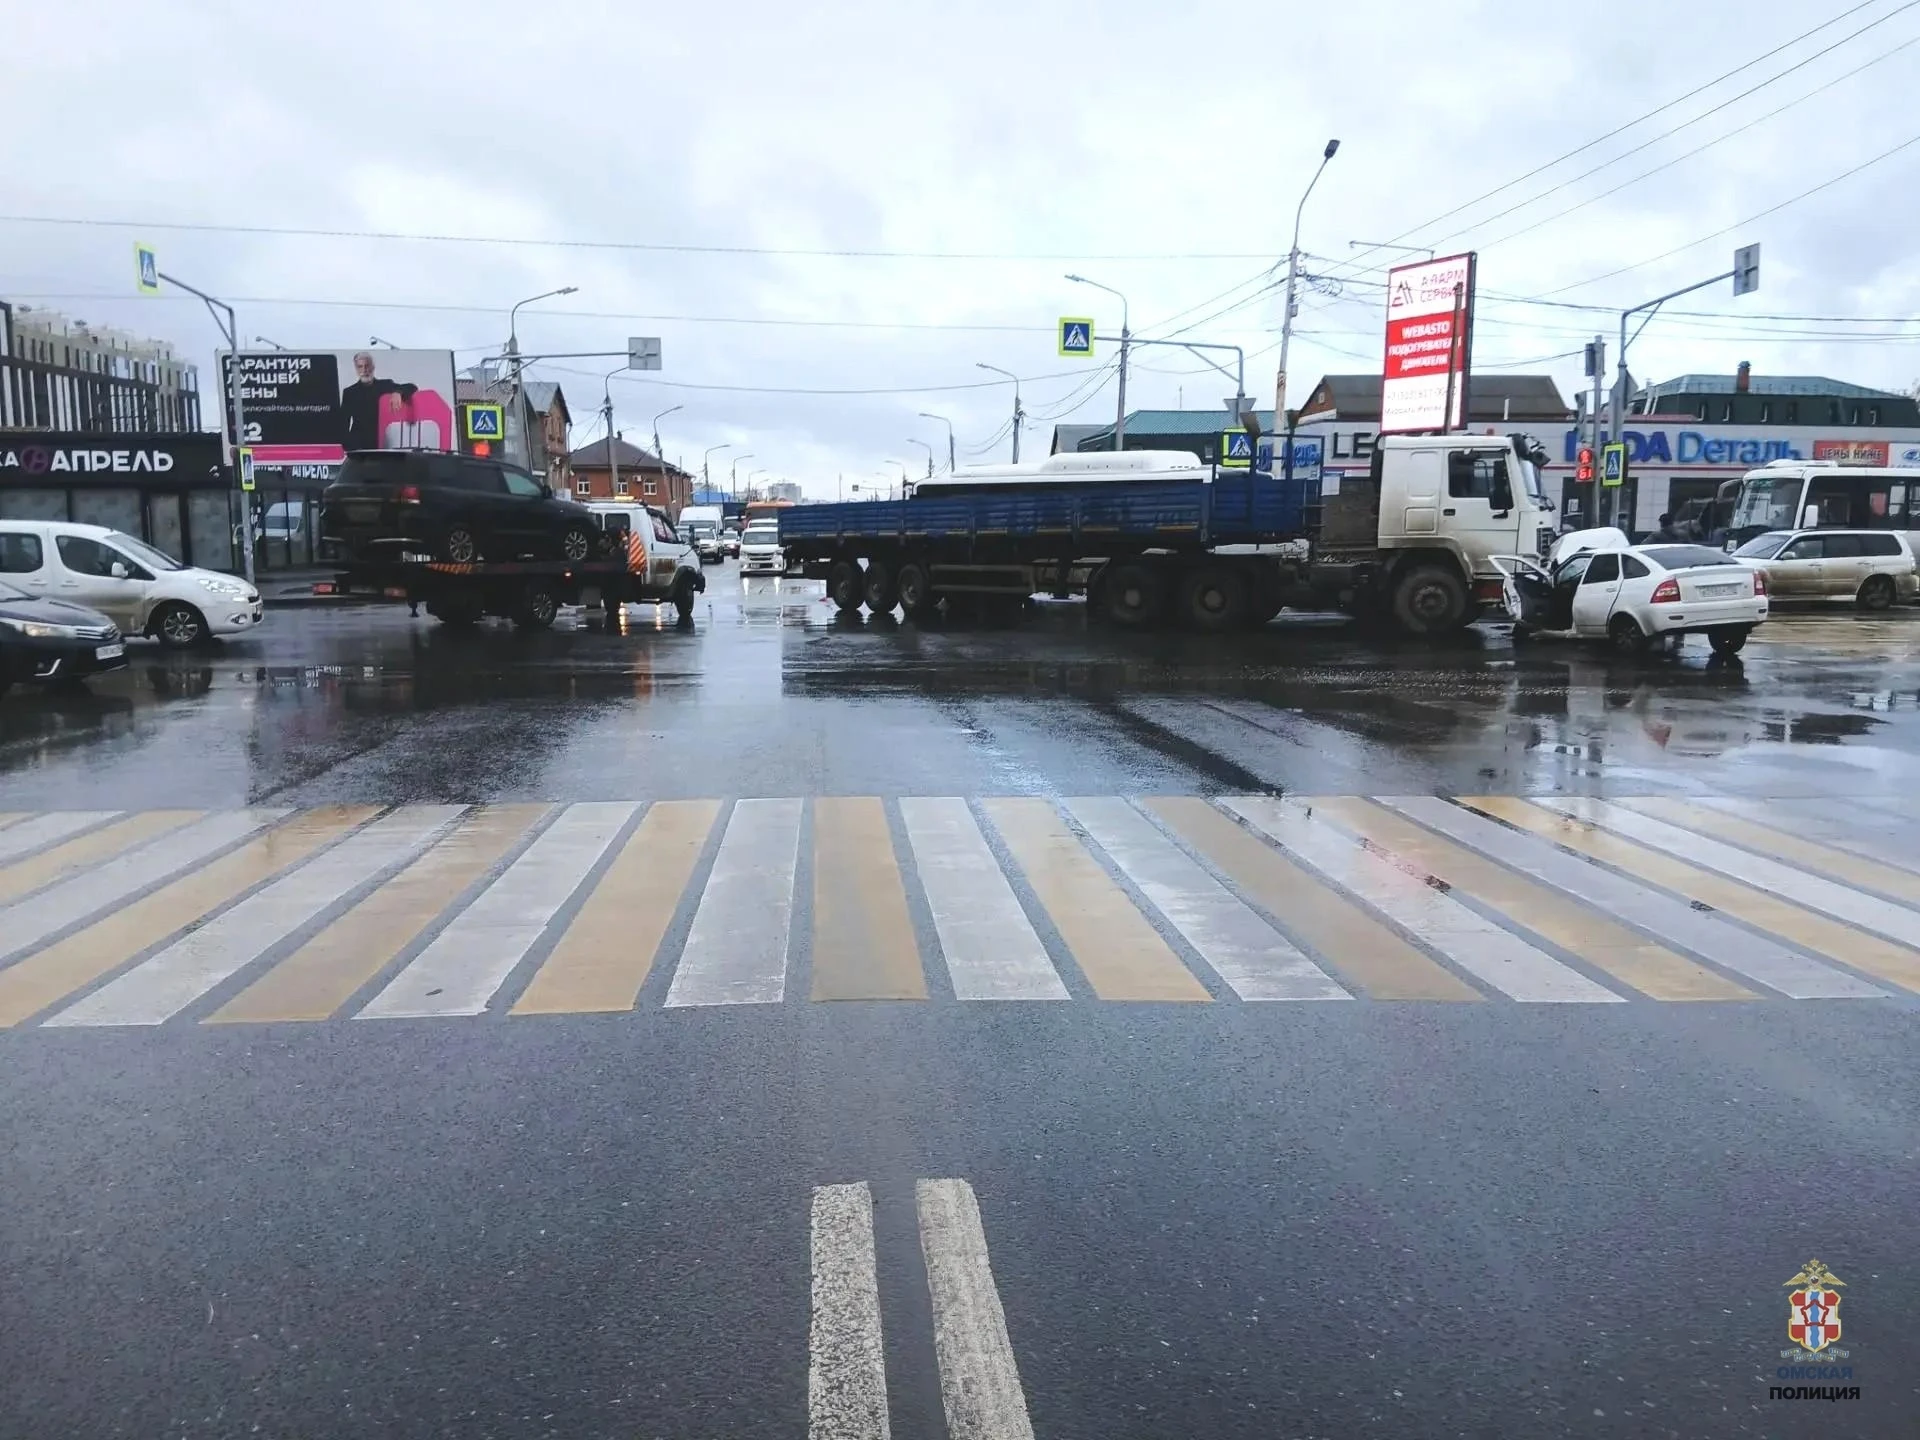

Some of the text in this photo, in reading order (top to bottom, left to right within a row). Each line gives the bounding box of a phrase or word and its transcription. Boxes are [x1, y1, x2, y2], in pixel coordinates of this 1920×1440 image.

[1402, 320, 1450, 339] WEBASTO
[1565, 431, 1672, 462] LDA
[50, 450, 173, 472] АПРЕЛЬ
